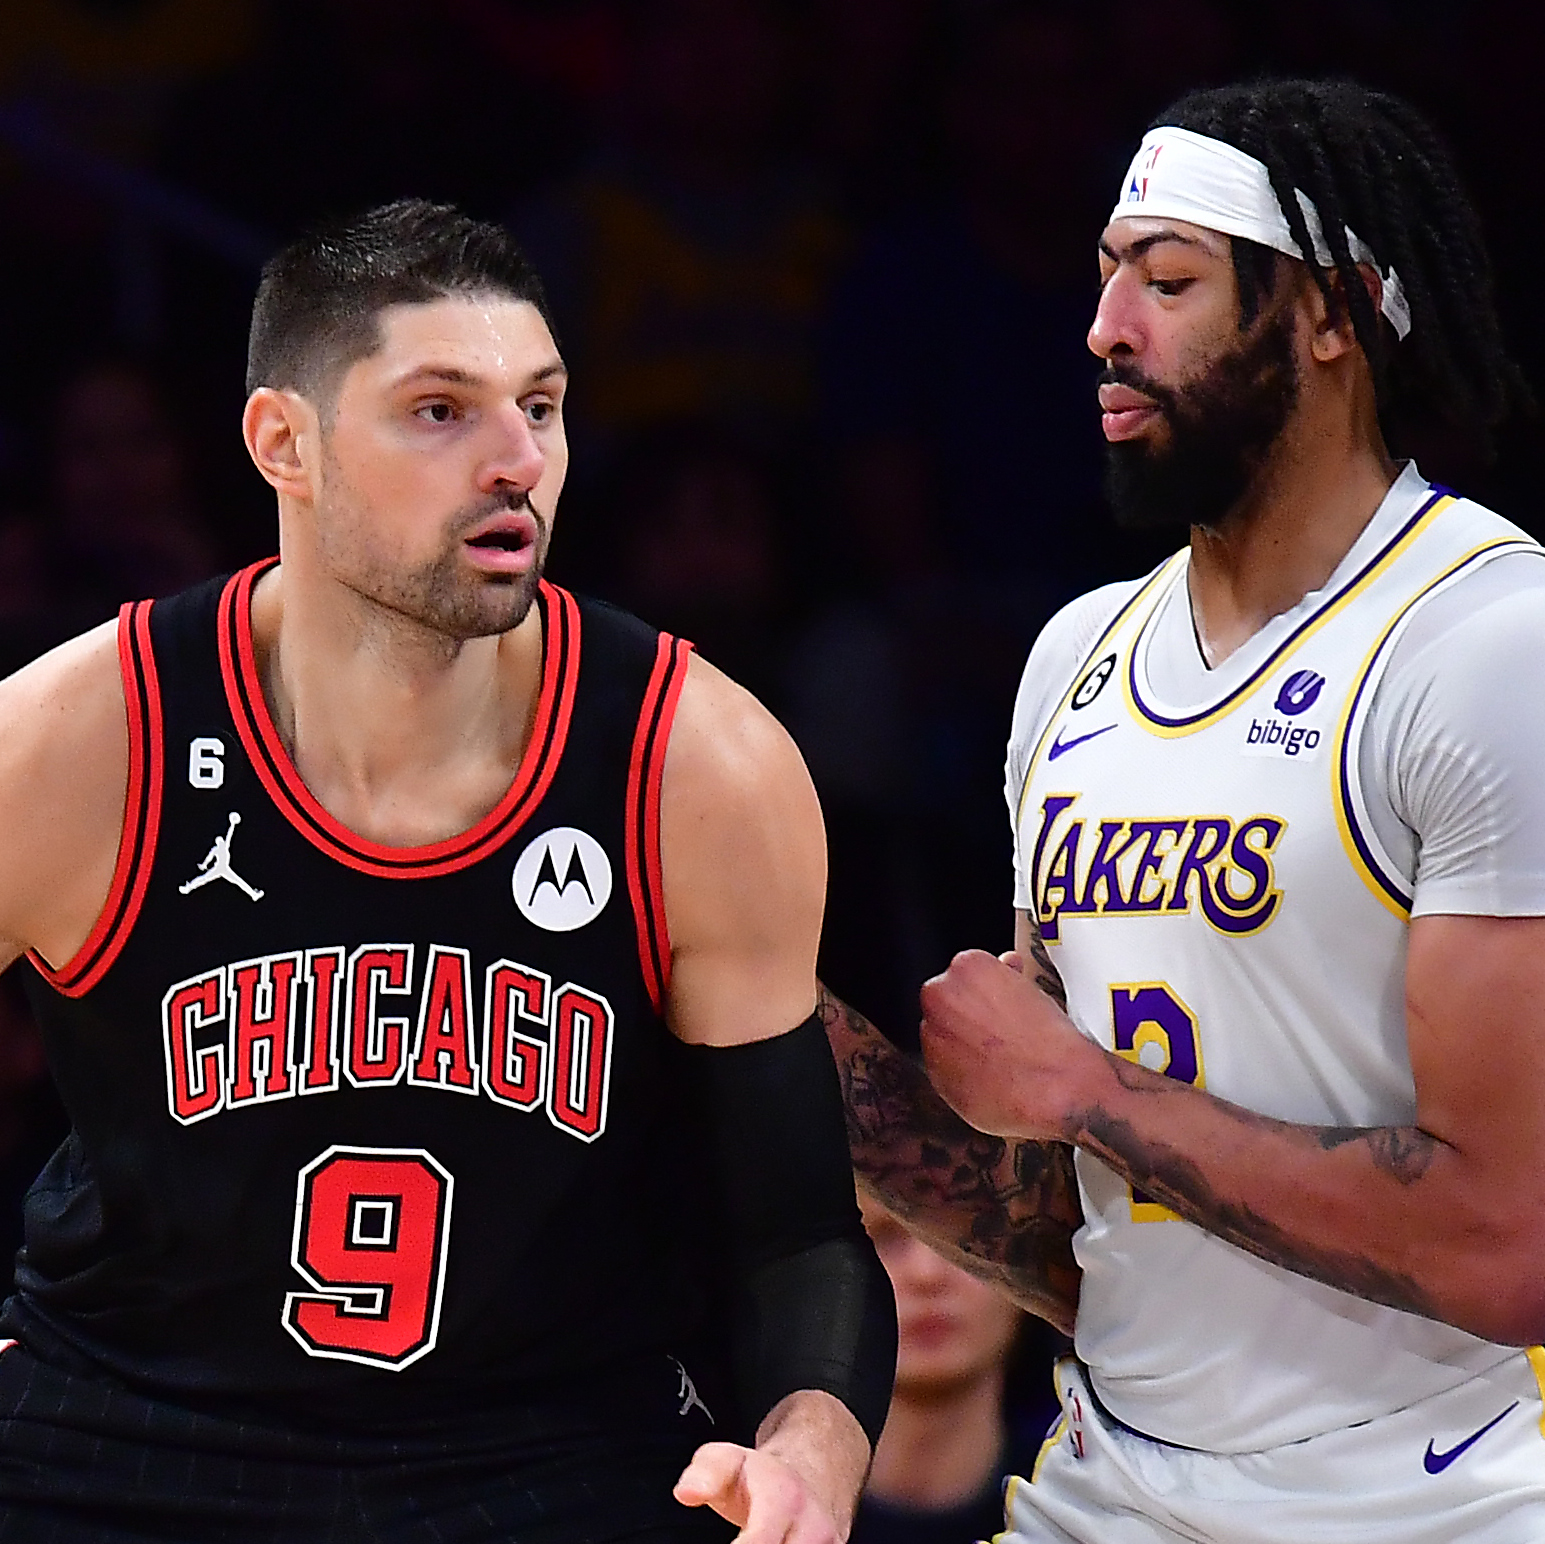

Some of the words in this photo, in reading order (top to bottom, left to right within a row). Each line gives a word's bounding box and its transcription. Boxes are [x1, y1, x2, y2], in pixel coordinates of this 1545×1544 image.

[1075, 658, 1113, 706] 6
[189, 737, 225, 789] 6
[1246, 718, 1320, 756] bibigo
[1031, 791, 1288, 946] LAKERS
[162, 943, 615, 1143] CHICAGO
[281, 1144, 454, 1371] 9
